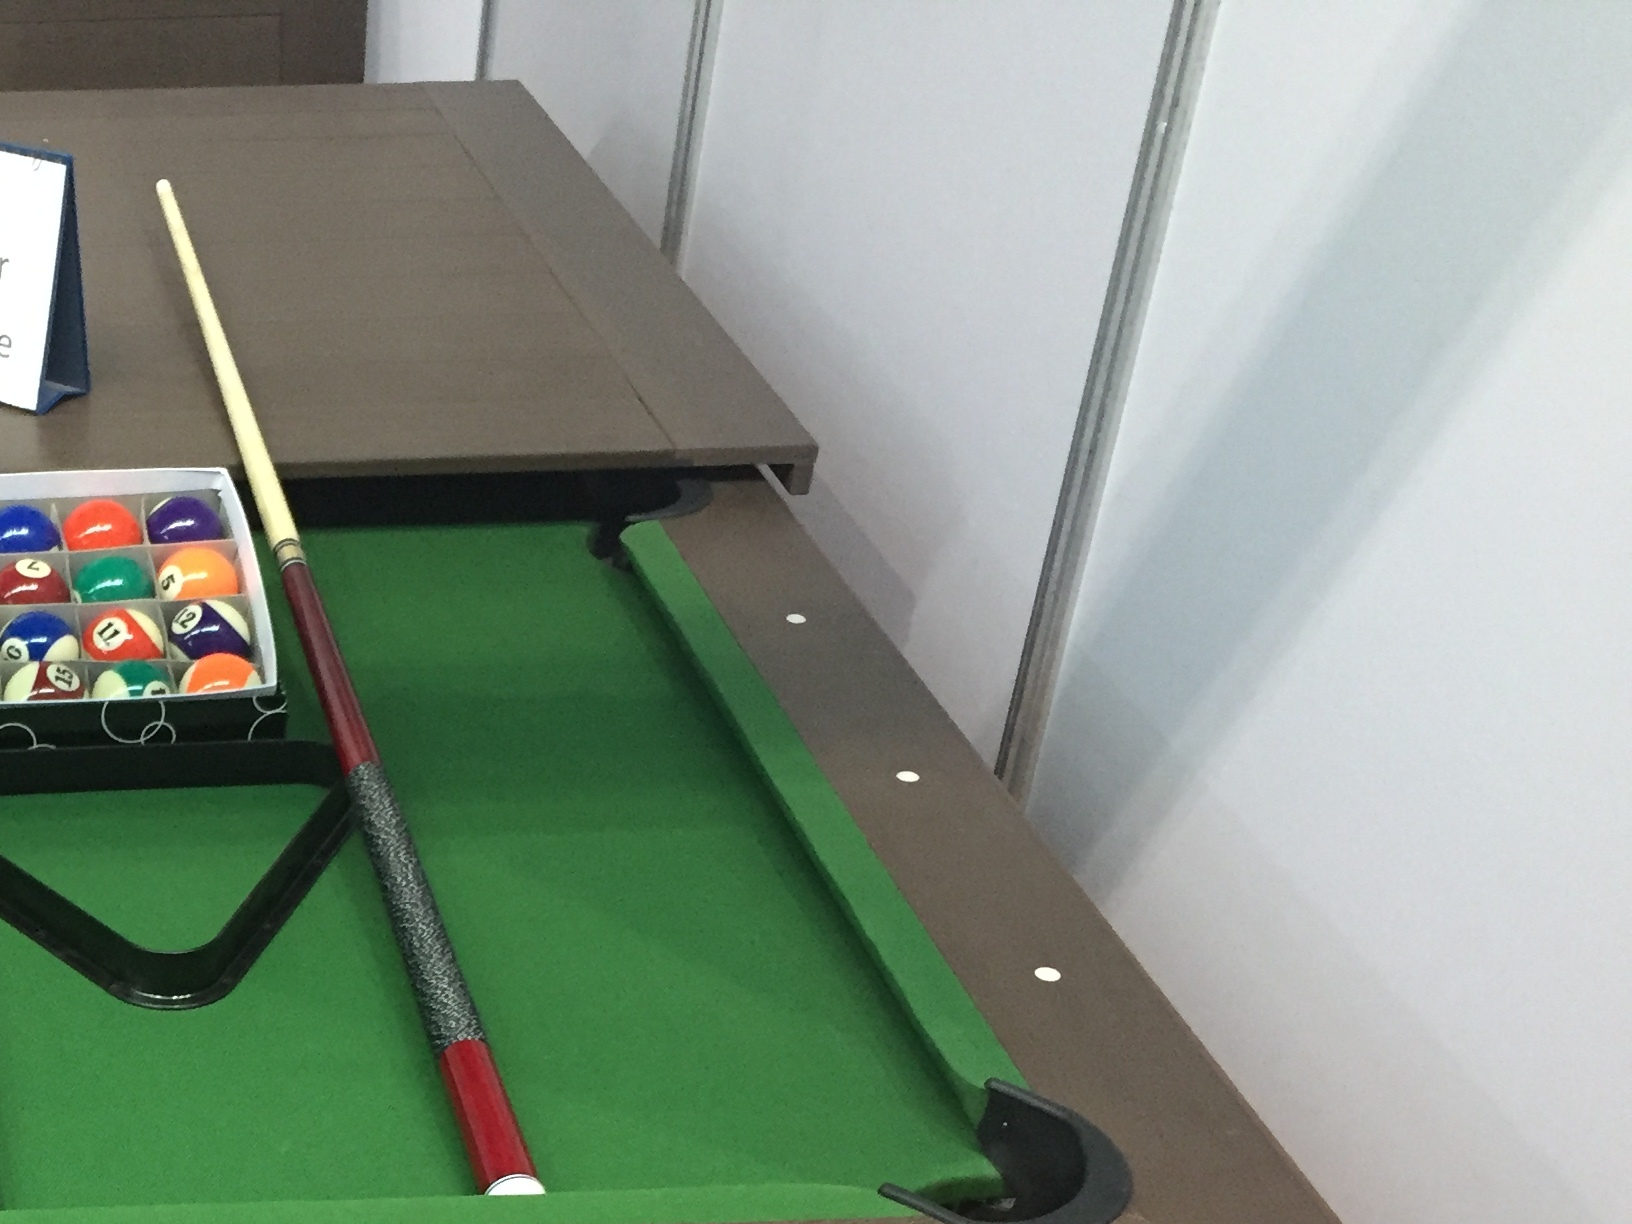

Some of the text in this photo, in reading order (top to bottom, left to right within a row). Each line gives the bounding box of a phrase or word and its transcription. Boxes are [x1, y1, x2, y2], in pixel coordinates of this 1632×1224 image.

[161, 574, 176, 591] 5
[173, 607, 197, 630] 12
[96, 621, 121, 646] 11
[54, 666, 75, 689] 15
